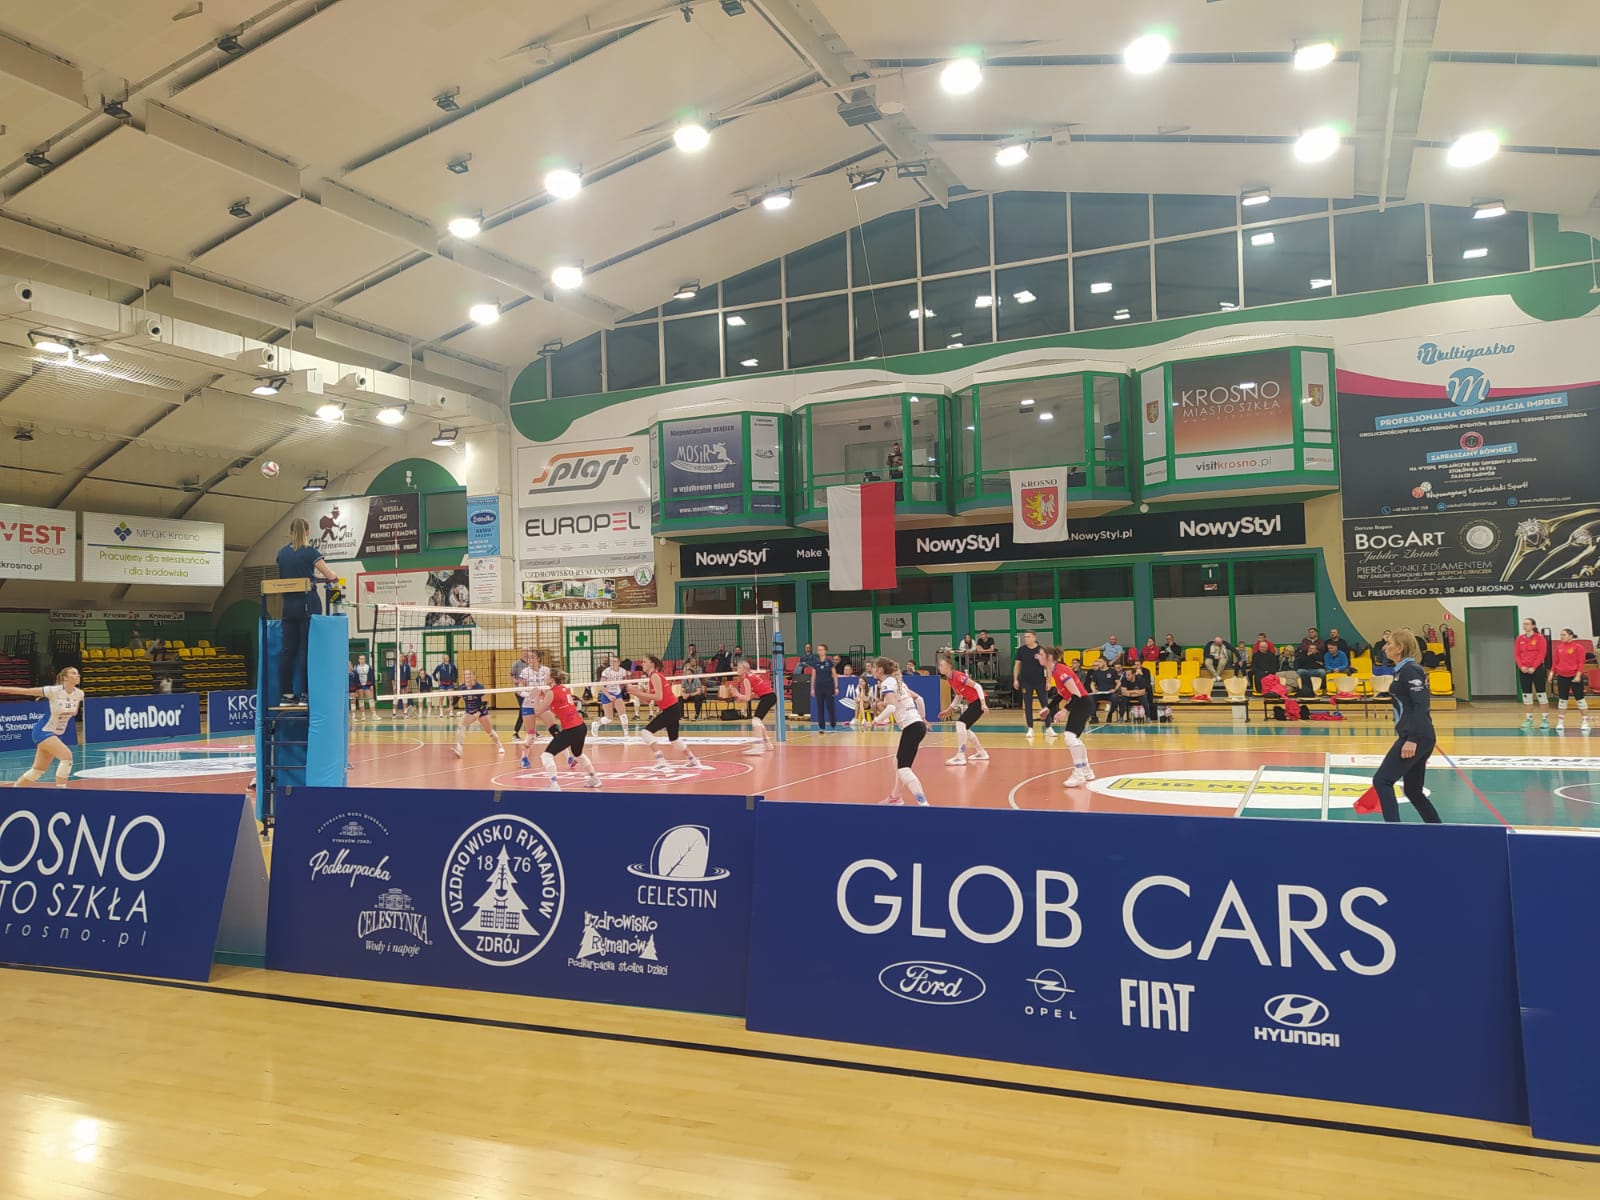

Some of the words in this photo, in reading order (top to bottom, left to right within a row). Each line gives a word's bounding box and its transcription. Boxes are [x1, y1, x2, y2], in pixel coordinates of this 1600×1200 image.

[1417, 343, 1515, 365] Multigastro
[1182, 381, 1280, 408] KROSNO
[1184, 405, 1234, 417] MIASTO
[1239, 400, 1281, 413] SZKŁA
[1380, 411, 1457, 427] PROFESJONALNA
[1459, 402, 1525, 417] ORGANIZACJA
[1527, 396, 1564, 408] IMPREZ
[677, 444, 711, 463] MOSiR
[1431, 449, 1479, 462] ZAPRASZAMY
[1196, 457, 1272, 471] visitkrosno.pl
[1021, 478, 1058, 488] KROSNO
[136, 529, 166, 539] MPGK
[392, 529, 417, 537] FRMOWE
[525, 512, 641, 537] EUROPEL
[1179, 514, 1281, 538] NowyStyl
[30, 546, 66, 556] GROUP
[916, 533, 1000, 553] NowyStyl
[0, 561, 42, 571] krosno.pl
[145, 554, 159, 563] dla
[696, 548, 767, 567] NowyStyl
[796, 549, 823, 559] Make
[1429, 560, 1493, 572] DIAMENTEM
[128, 567, 143, 576] dla
[1367, 587, 1428, 597] PIŁSUDSKIEGO
[1476, 583, 1515, 593] KROSNO
[6, 723, 37, 732] Stosow
[104, 705, 182, 731] DefenDoor
[0, 810, 165, 881] OSNO
[309, 848, 392, 888] Podkarpacka
[449, 825, 513, 914] UZDROWISKO
[515, 829, 560, 919] RYMANÓW
[477, 855, 494, 871] 18
[513, 856, 532, 873] 76
[46, 882, 148, 924] SZKŁA
[637, 884, 717, 909] CELESTIN
[836, 858, 1083, 949] GLOB
[1122, 875, 1397, 976] CARS
[358, 910, 429, 945] CELESTYNKA
[365, 940, 385, 954] Wody
[392, 943, 420, 957] napoje
[476, 934, 521, 955] ZDRÓJ
[900, 965, 964, 998] Ford
[1025, 1006, 1077, 1020] OPEL
[1120, 978, 1195, 1033] FIAT
[1254, 1026, 1340, 1048] HYUNDAI
